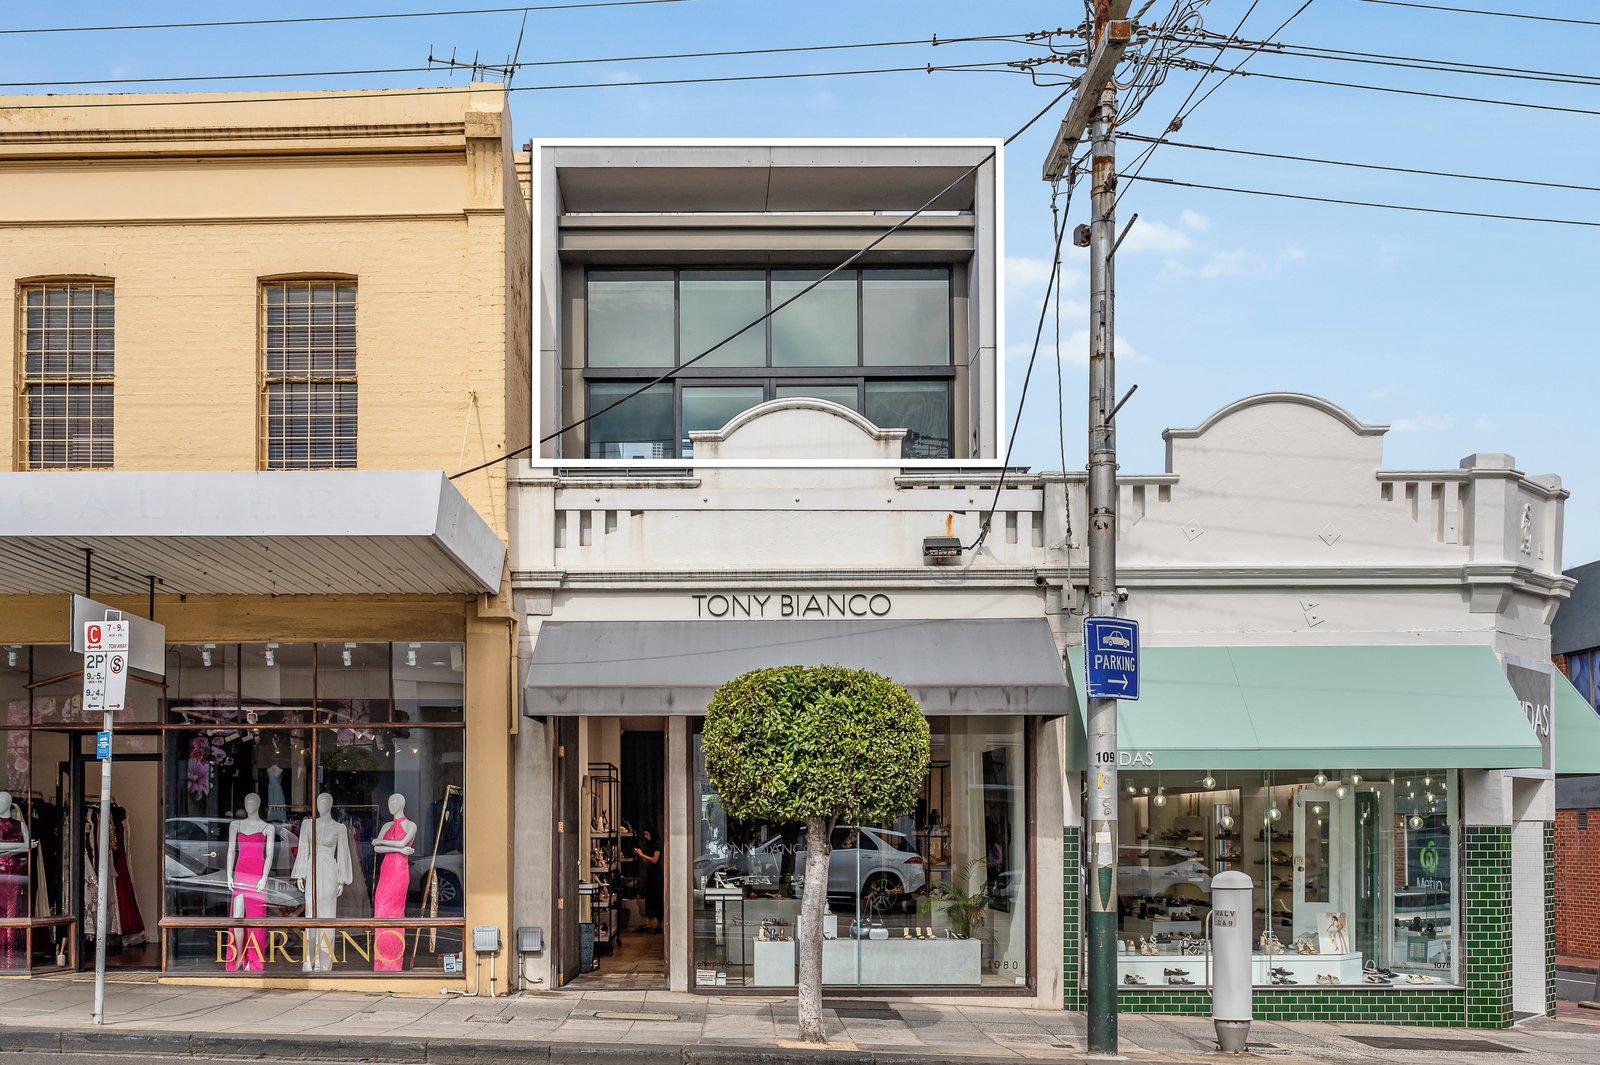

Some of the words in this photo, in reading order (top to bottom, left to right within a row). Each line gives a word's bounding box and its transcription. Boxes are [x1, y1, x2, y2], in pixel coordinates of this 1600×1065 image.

[691, 594, 771, 617] TONY
[781, 593, 891, 617] BIANCO
[86, 654, 104, 669] 2P
[1094, 654, 1135, 672] PARKING
[215, 930, 406, 963] BARIANO
[696, 960, 726, 968] afterpay
[988, 960, 1019, 970] 1080
